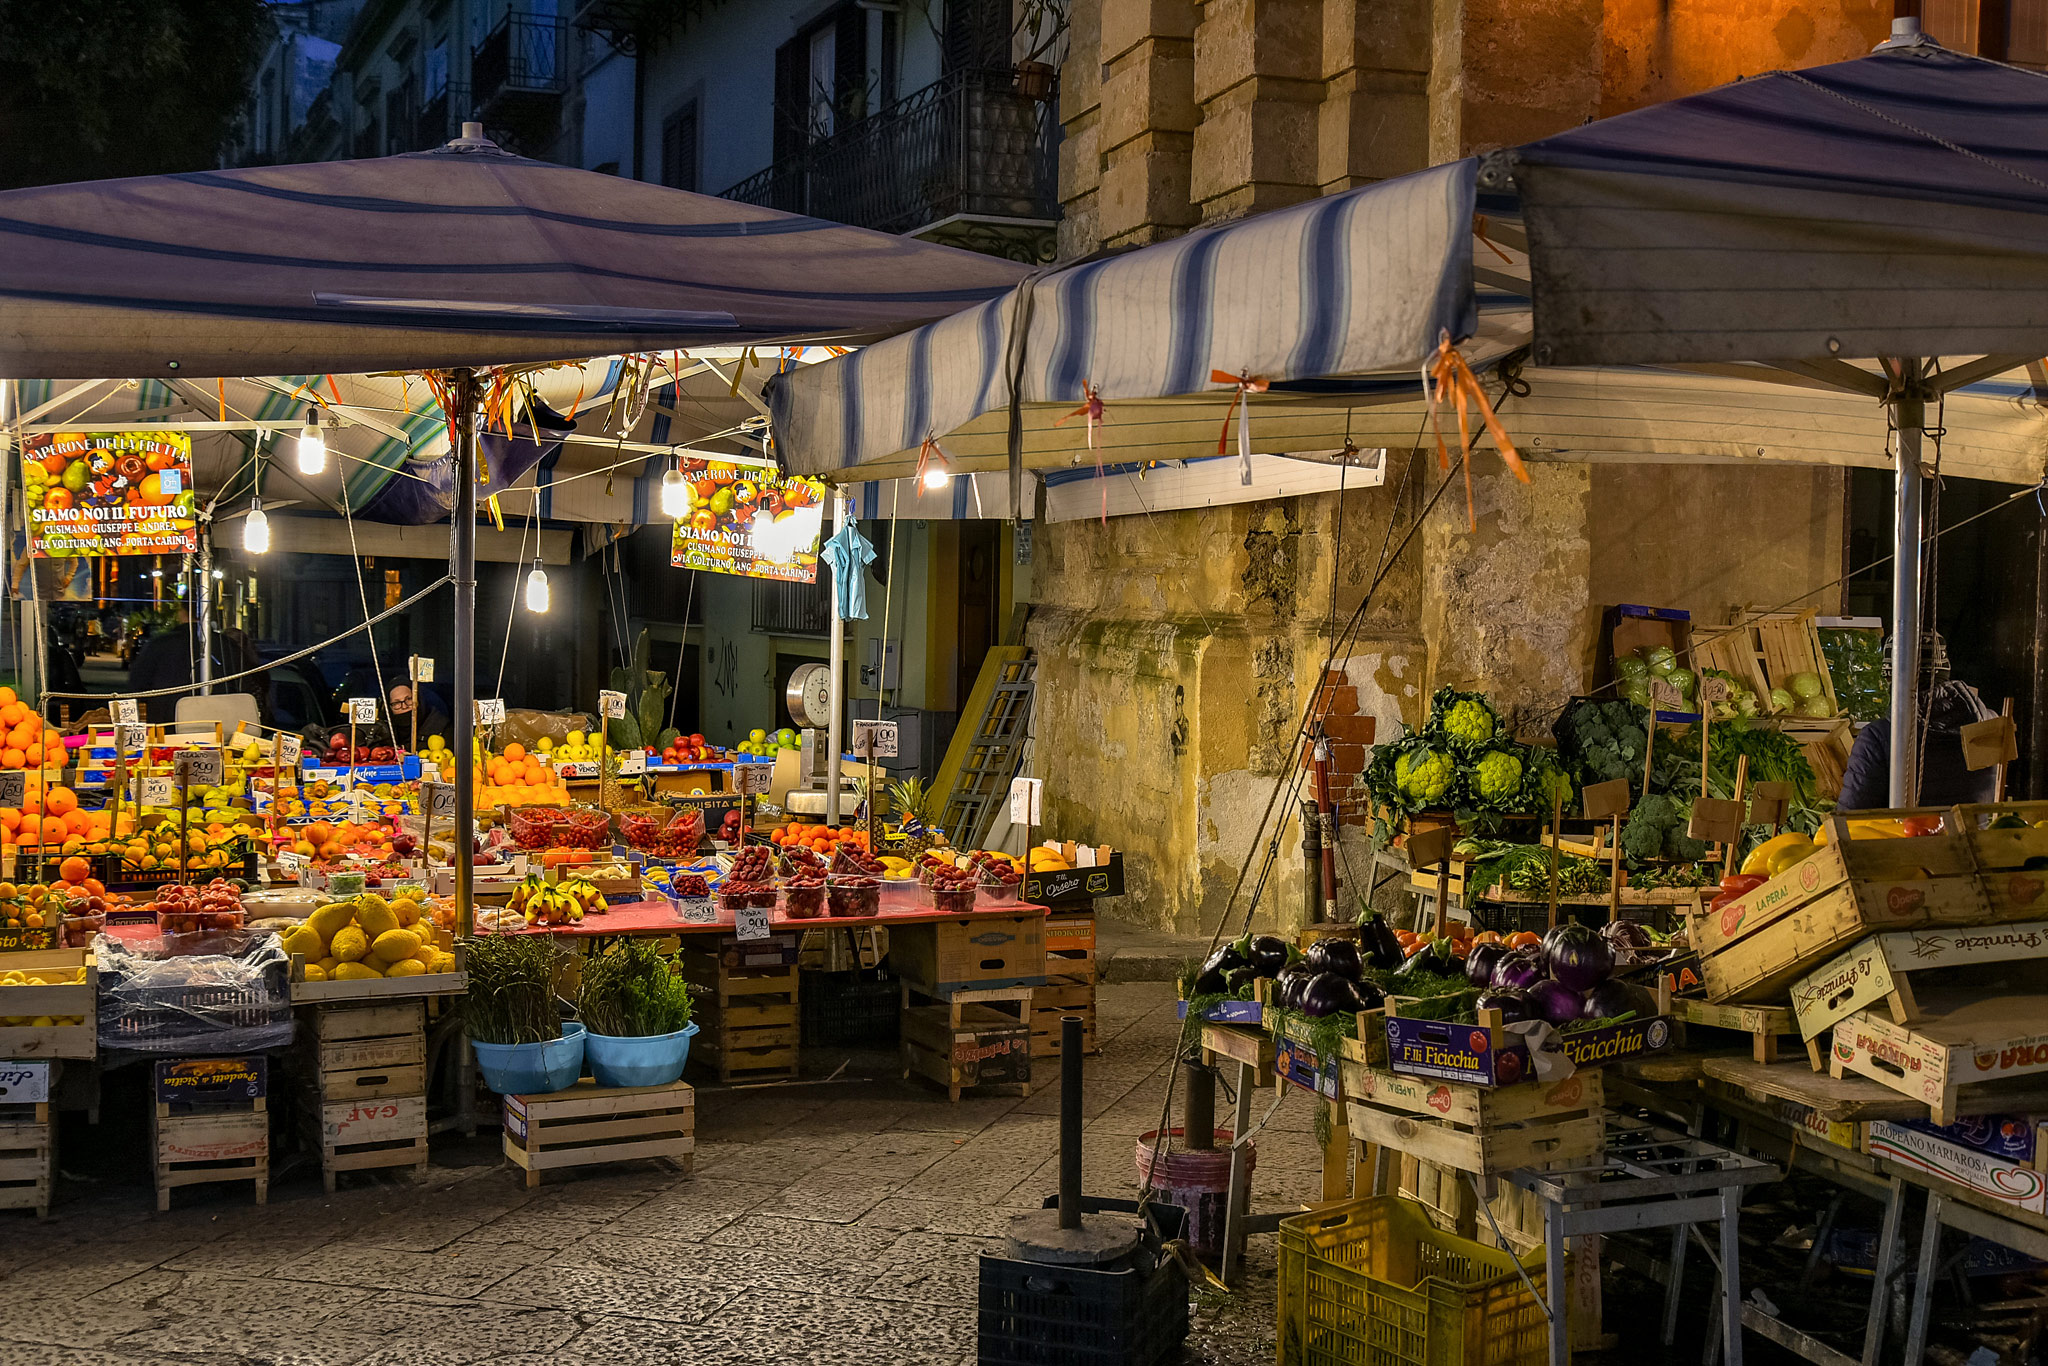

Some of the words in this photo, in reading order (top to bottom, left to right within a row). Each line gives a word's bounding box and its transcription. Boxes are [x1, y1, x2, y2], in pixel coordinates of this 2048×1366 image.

[24, 438, 92, 465] PAPERONE
[96, 438, 135, 450] DELLA
[139, 439, 187, 462] FRUTTA
[683, 469, 740, 484] PAPERONE
[743, 470, 777, 485] DELLA
[32, 508, 80, 522] SIAMO
[82, 507, 109, 521] NOI
[110, 507, 125, 520] IL
[129, 505, 188, 520] FUTURO
[44, 523, 90, 534] CUSIMANO
[91, 522, 134, 534] GIUSEPPE
[134, 522, 140, 532] E
[142, 521, 178, 532] ANDREA
[679, 525, 720, 542] SIAMO
[722, 531, 746, 546] NOI
[34, 539, 50, 550] VIA
[52, 538, 98, 549] VOLTURNO
[100, 537, 123, 549] (ANG.
[125, 536, 154, 547] PORTA
[155, 535, 188, 546] CARINI)
[687, 541, 726, 556] CUSIMANO
[727, 547, 763, 560] GIUSEPPE
[677, 553, 691, 564] VIA
[692, 555, 732, 570] VOLTURNO
[733, 560, 753, 572] (ANG.
[756, 563, 779, 575] PORTA
[780, 567, 810, 580] CARINI)
[1046, 878, 1080, 897] Orsero
[1756, 899, 1767, 912] LA
[1766, 885, 1789, 907] PERA!
[1954, 932, 2042, 951] Primizie
[1858, 957, 1872, 977] Le
[1815, 967, 1860, 1001] Primizie
[1719, 1019, 1742, 1030] FUNGO
[1013, 1039, 1028, 1054] Le
[1562, 1028, 1643, 1064] Ficicchia
[1855, 1033, 1923, 1073] AURORA
[1425, 1045, 1480, 1070] Ficicchia
[163, 1075, 200, 1087] Sicilia
[211, 1071, 259, 1084] Prodotti
[1387, 1083, 1406, 1097] PERA!
[1405, 1086, 1416, 1098] LA
[1429, 1093, 1450, 1109] Opera
[345, 1105, 399, 1122] GAF
[167, 1144, 220, 1159] Azzurro
[1873, 1122, 1925, 1150] TROPEANO
[1926, 1141, 1989, 1174] MARIAROSA
